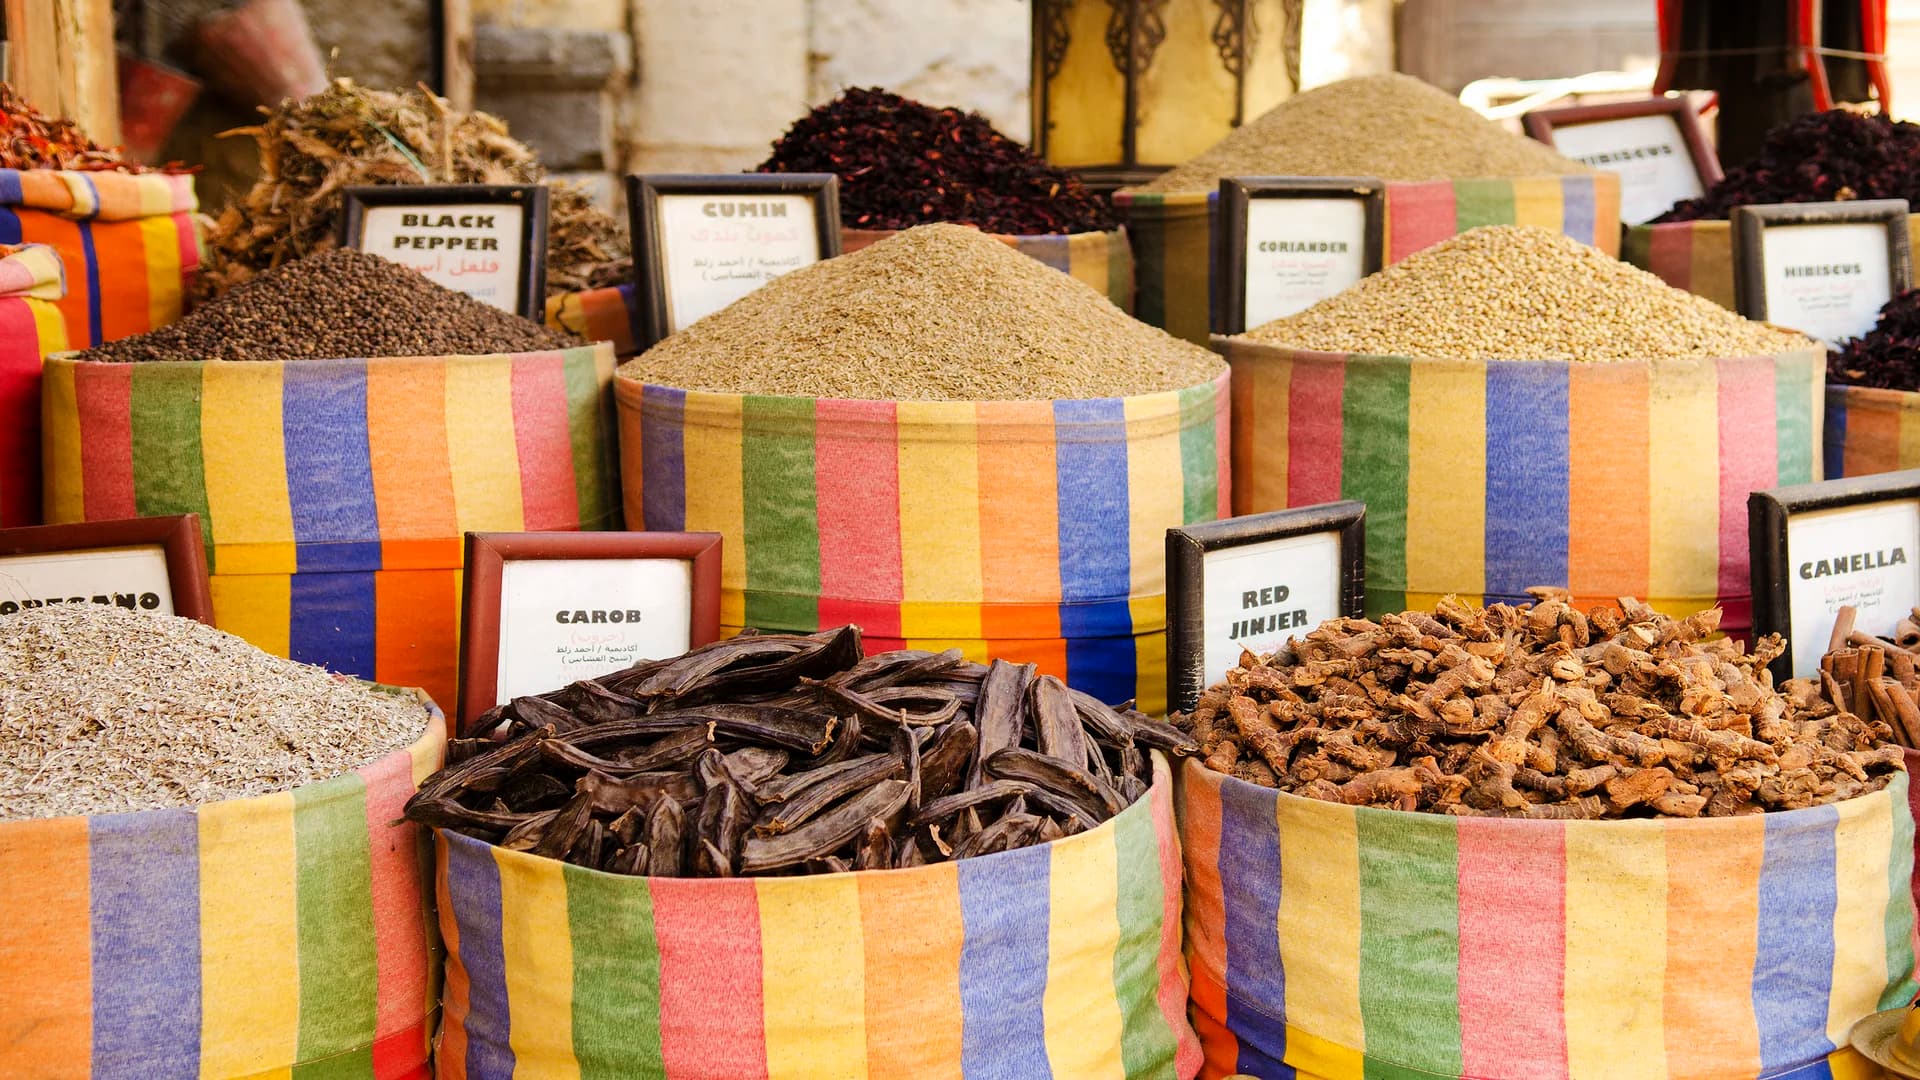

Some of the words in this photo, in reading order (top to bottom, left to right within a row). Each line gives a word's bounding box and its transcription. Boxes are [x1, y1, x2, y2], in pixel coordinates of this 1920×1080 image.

[702, 202, 787, 217] CUMIN
[402, 214, 495, 228] BLACK
[393, 236, 498, 250] PEPPER
[1259, 241, 1348, 253] CORIANDER
[1785, 264, 1862, 278] HIBISCUS
[1800, 547, 1906, 580] CANELLA
[1242, 585, 1290, 609] RED
[556, 609, 641, 624] CAROB
[1229, 609, 1308, 640] JINJER
